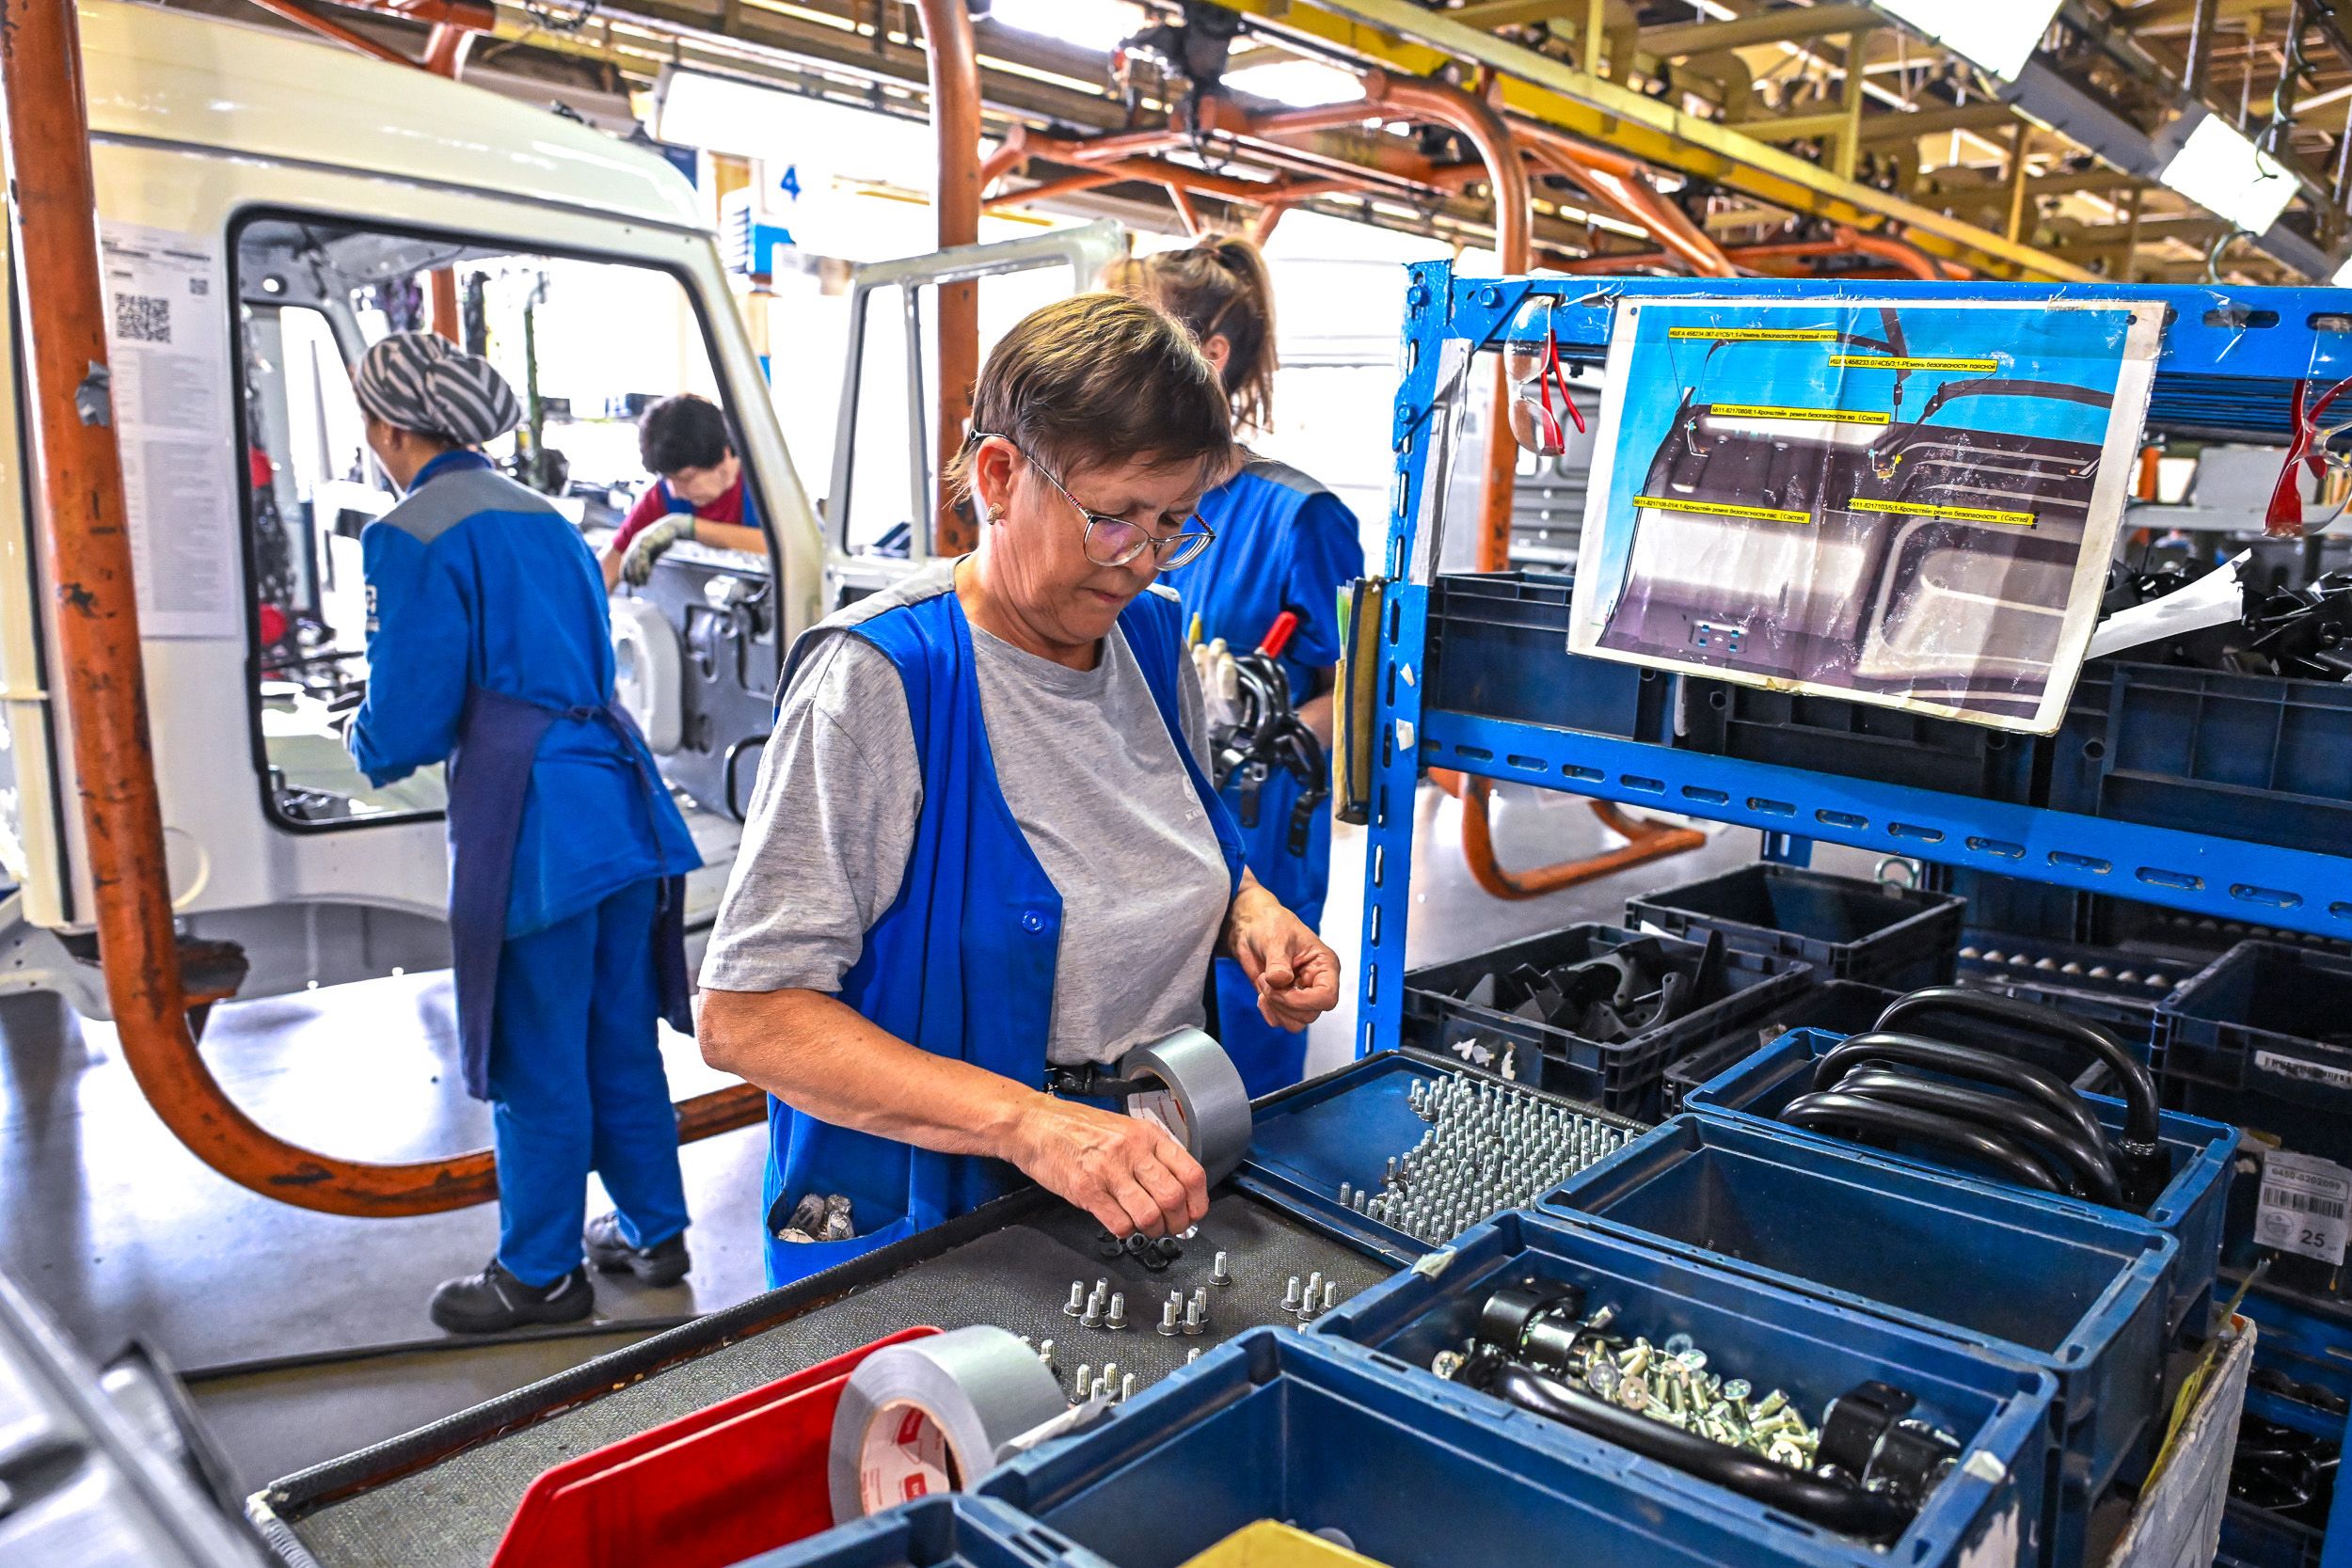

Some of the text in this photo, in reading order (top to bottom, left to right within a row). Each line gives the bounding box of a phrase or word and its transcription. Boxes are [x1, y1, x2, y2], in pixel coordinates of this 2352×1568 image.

[780, 164, 802, 202] 4
[1807, 411, 1847, 420] безопасности
[1954, 511, 1997, 520] безопасности
[2301, 1228, 2326, 1248] 25
